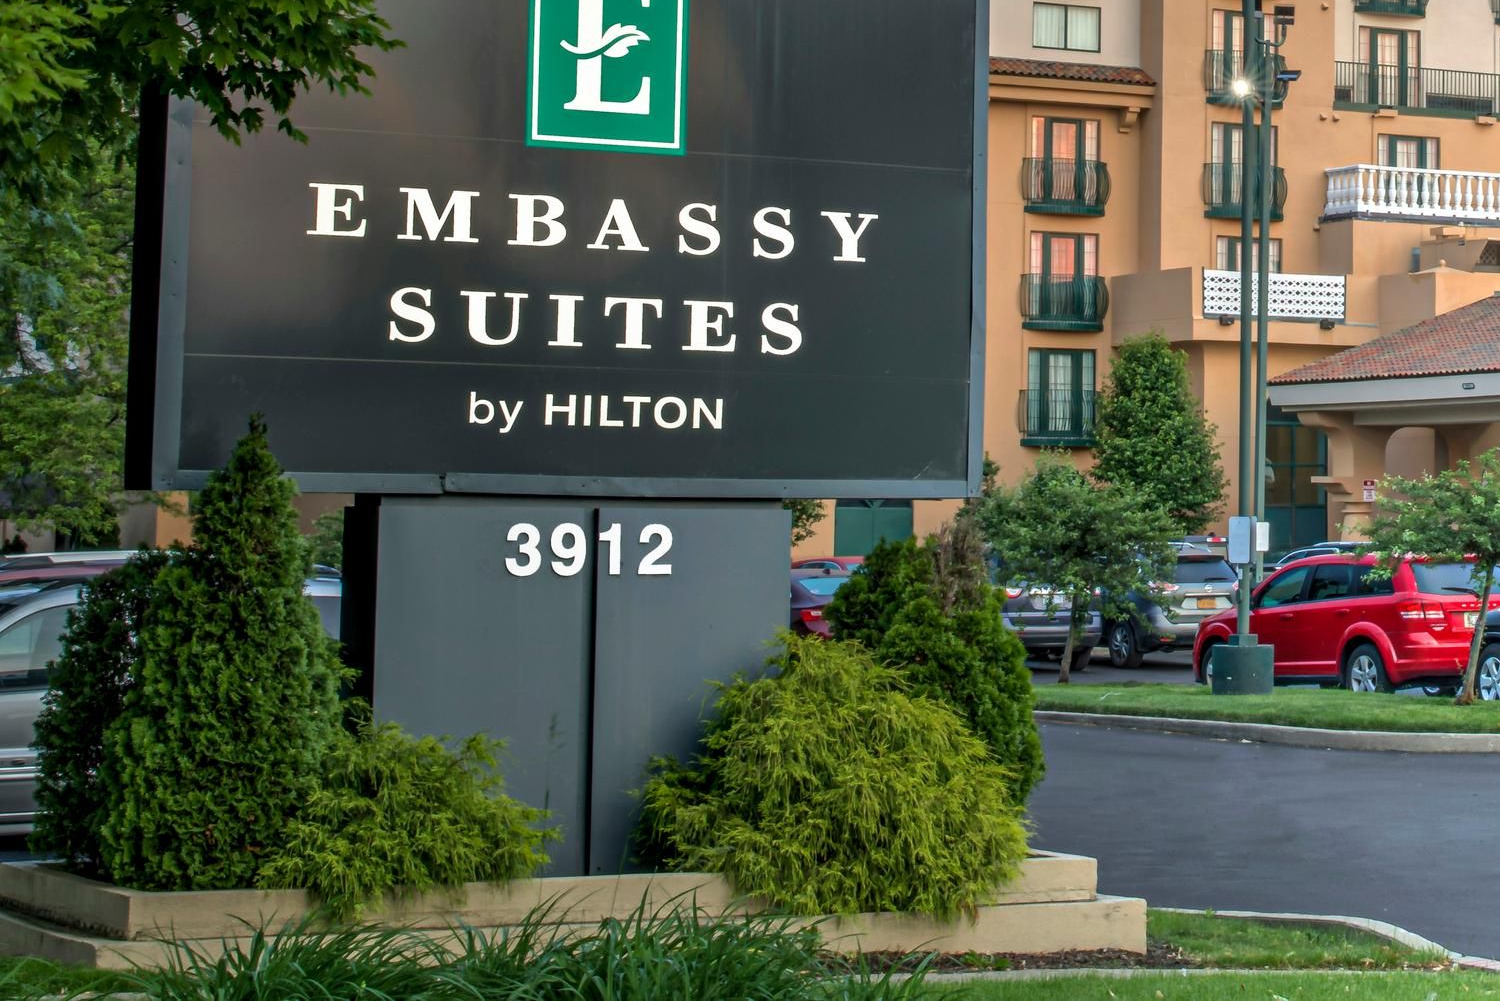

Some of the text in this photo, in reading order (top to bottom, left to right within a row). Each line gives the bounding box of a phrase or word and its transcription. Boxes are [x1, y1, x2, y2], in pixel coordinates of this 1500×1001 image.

[306, 182, 879, 263] EMBASSY
[389, 286, 803, 356] SUITES
[468, 391, 725, 434] by HILTON
[504, 522, 674, 577] 3912
